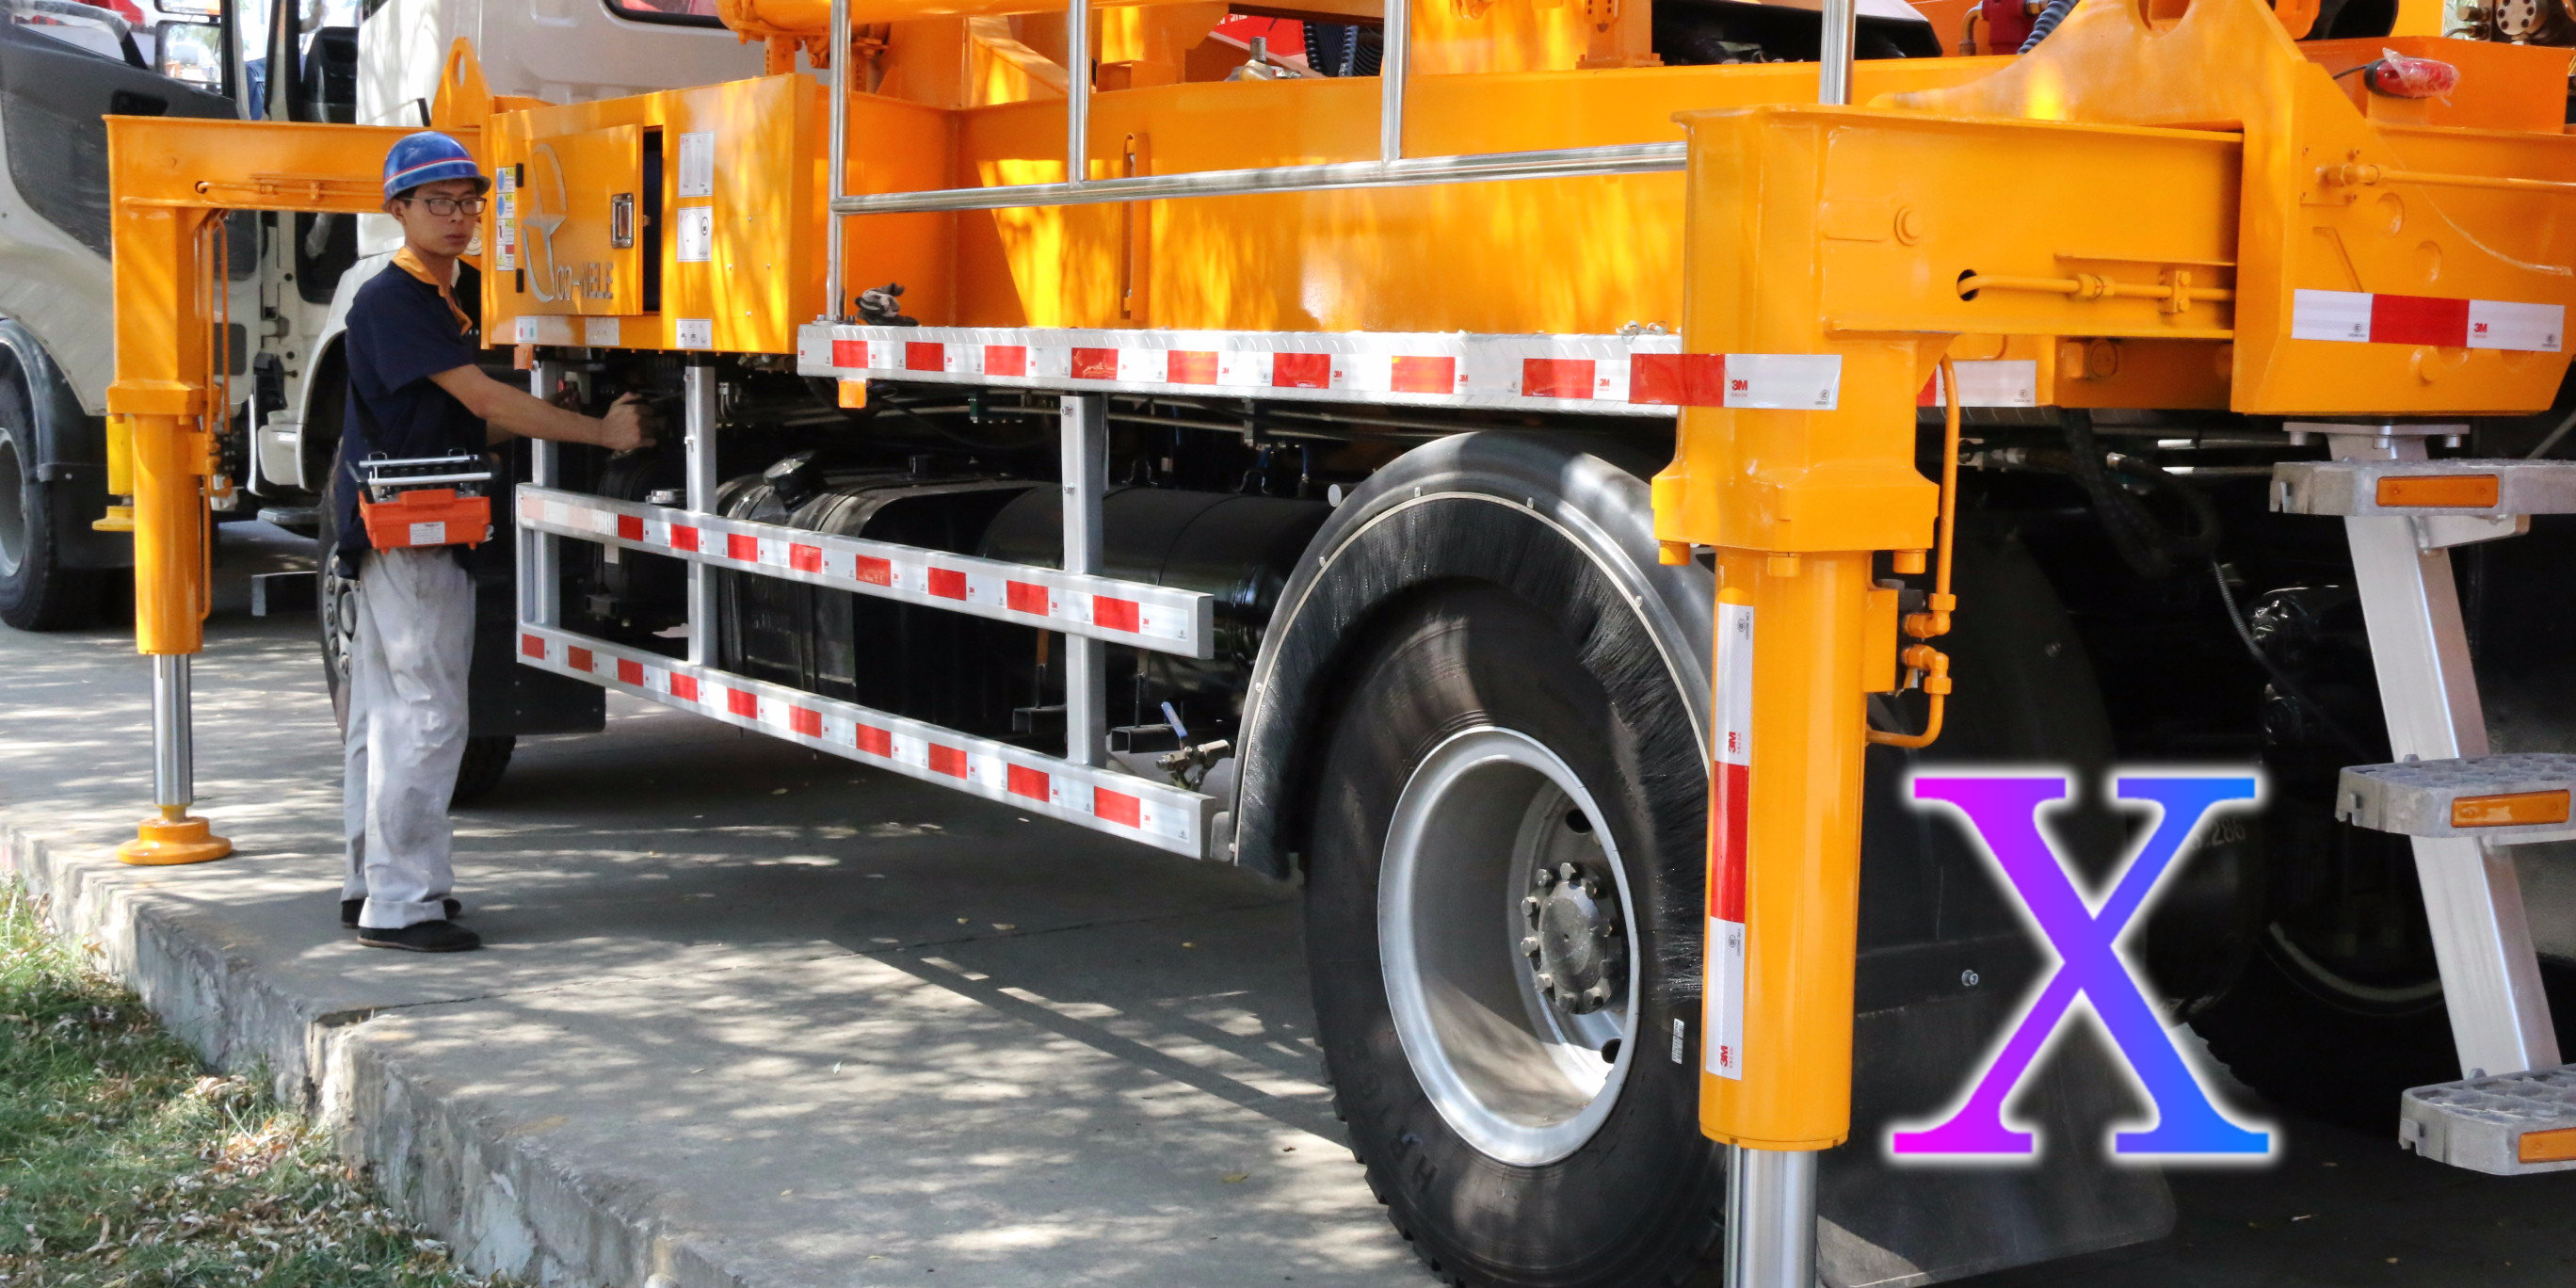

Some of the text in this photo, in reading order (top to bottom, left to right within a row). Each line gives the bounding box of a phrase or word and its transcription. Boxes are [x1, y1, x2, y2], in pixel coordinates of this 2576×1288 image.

[2473, 322, 2488, 333] 3M
[1333, 370, 1343, 378] 3M
[1458, 374, 1469, 382] 3M
[1600, 378, 1610, 387] 3M
[1731, 379, 1748, 391] 3M
[1728, 731, 1736, 753] 3M
[1720, 1045, 1729, 1068] 3M
